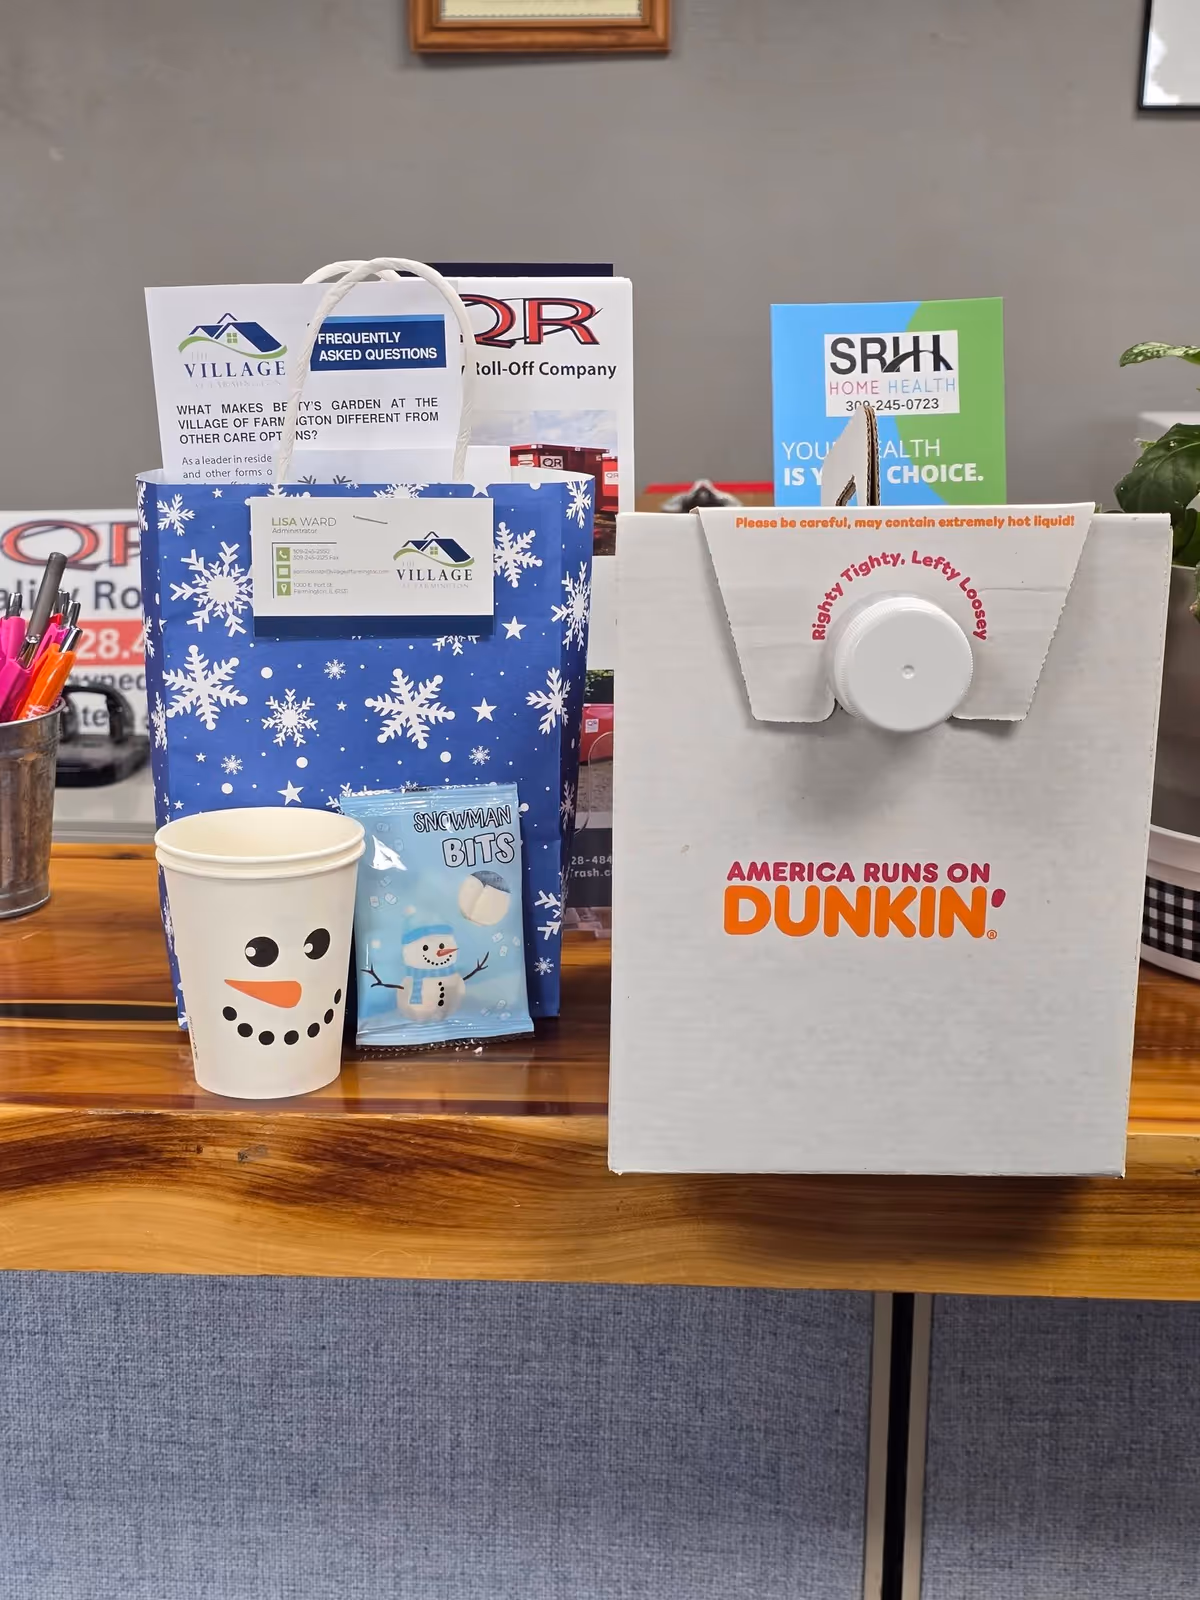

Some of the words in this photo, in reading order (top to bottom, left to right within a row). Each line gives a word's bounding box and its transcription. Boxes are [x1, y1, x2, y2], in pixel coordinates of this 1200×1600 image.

[318, 332, 401, 344] FREQUENTLY
[319, 350, 362, 361] ASKED
[365, 348, 437, 360] QUESTIONS
[184, 361, 286, 378] VILLAGE
[539, 362, 617, 379] Company
[829, 380, 879, 396] HOME
[888, 378, 956, 393] HEALTH
[176, 405, 211, 415] WHAT
[221, 403, 264, 414] MAKES
[273, 401, 322, 411] BETY'S
[331, 399, 381, 410] GARDEN
[391, 398, 406, 408] AT
[415, 397, 438, 407] THE
[178, 418, 229, 430] VILLAGE
[233, 418, 249, 428] OF
[254, 415, 332, 427] FARMGTON
[337, 413, 401, 424] DIFFERENT
[405, 412, 439, 422] FROM
[180, 434, 220, 445] OTHER
[223, 432, 256, 443] CARE
[260, 430, 318, 442] OPTNS?
[182, 457, 193, 465] As
[202, 456, 232, 465] leader
[234, 455, 242, 464] in
[244, 454, 272, 463] reside
[782, 441, 838, 460] YOU
[183, 470, 201, 479] and
[205, 469, 231, 478] other
[235, 468, 262, 477] forms
[784, 468, 804, 486] IS
[887, 463, 985, 484] CHOICE.
[272, 517, 297, 527] LISA
[299, 517, 337, 527] WARD
[735, 517, 777, 529] Please
[781, 517, 797, 529] be
[800, 517, 851, 530] careful,
[855, 519, 882, 530] may
[885, 517, 936, 529] contain
[938, 516, 1005, 530] extremely
[1008, 515, 1031, 528] hot
[1033, 515, 1075, 529] liquid!
[396, 568, 473, 581] VILLAGE
[94, 580, 141, 610] Ro
[811, 583, 844, 640] Righty
[840, 551, 906, 582] Tighty,
[911, 550, 961, 581] Lefty
[958, 577, 987, 640] Loosey
[413, 804, 512, 833] SNOWMAN
[442, 832, 516, 868] BITS
[727, 861, 856, 883] AMERICA
[864, 862, 939, 883] RUNS
[947, 862, 990, 884] ON
[723, 884, 1007, 939] DUNKIN'
